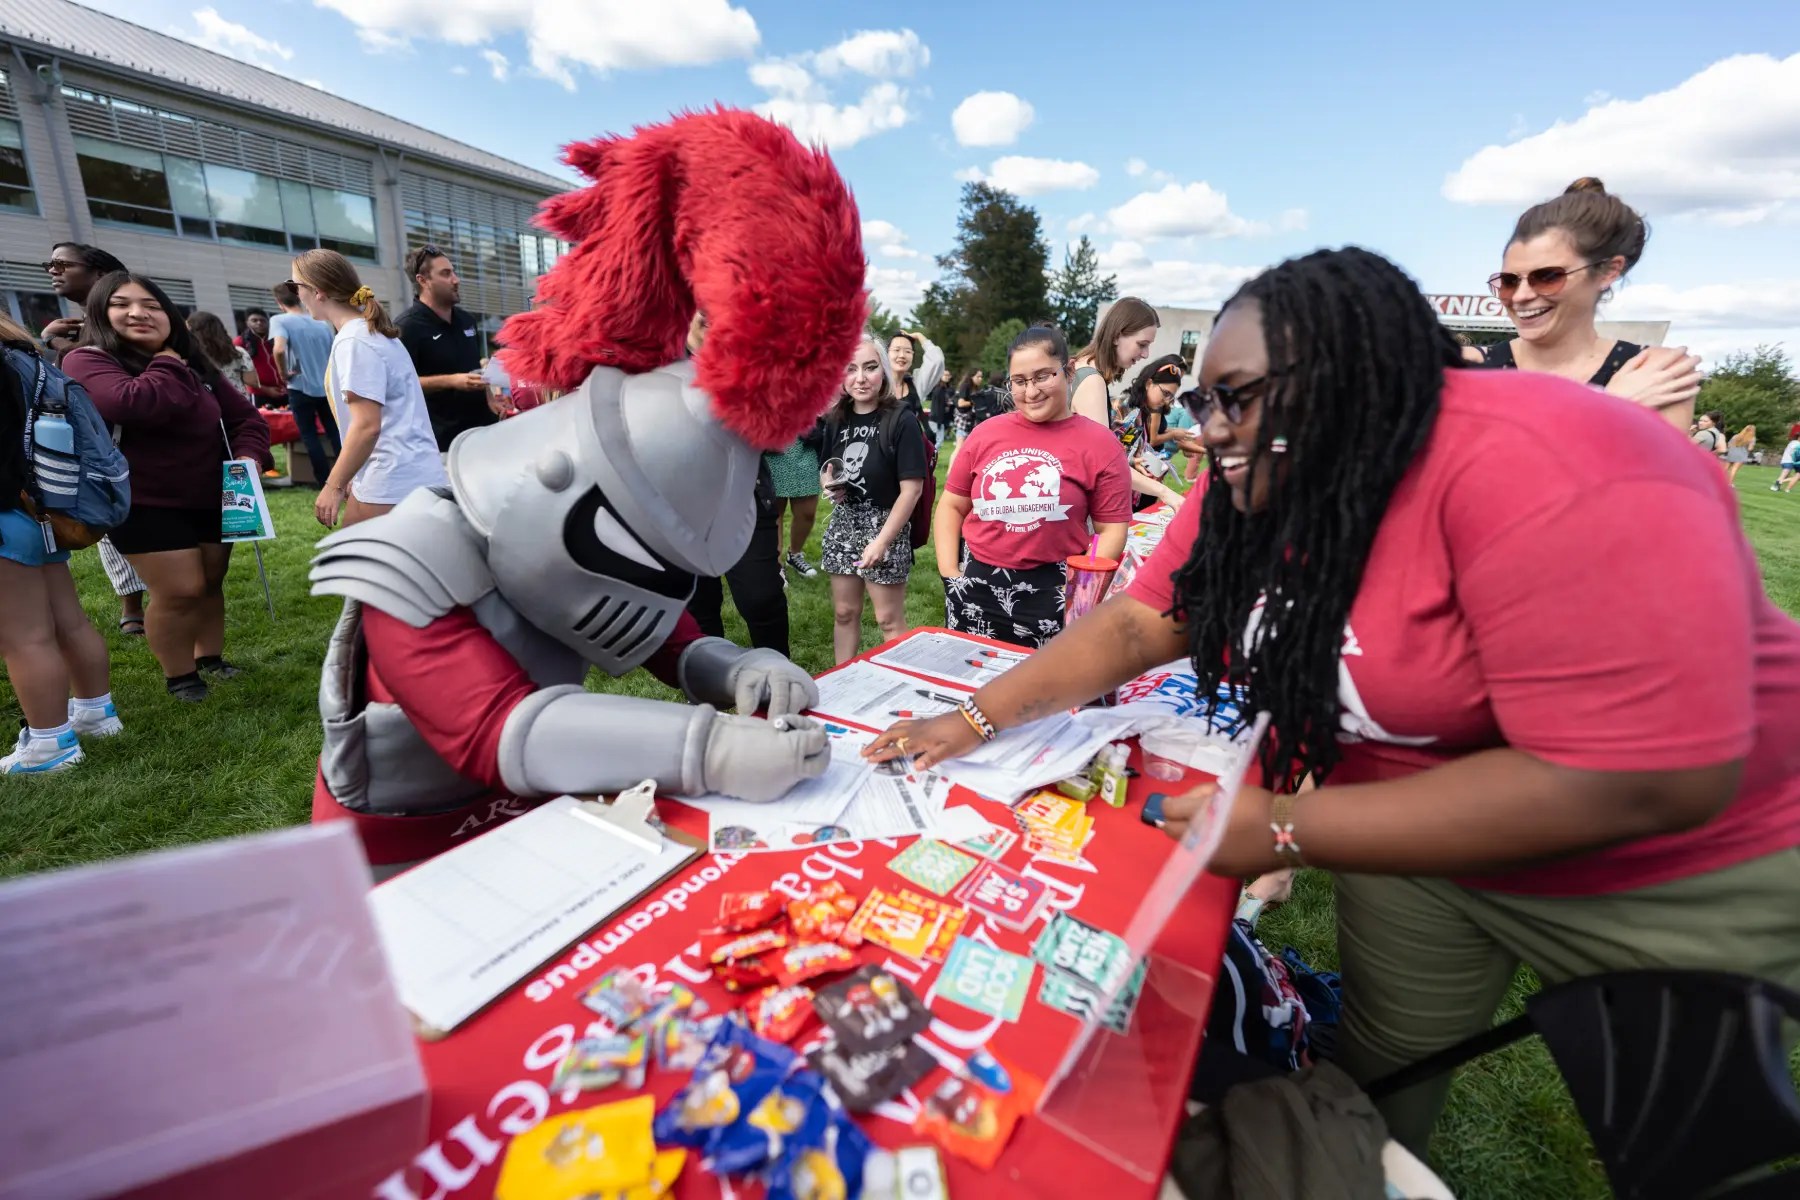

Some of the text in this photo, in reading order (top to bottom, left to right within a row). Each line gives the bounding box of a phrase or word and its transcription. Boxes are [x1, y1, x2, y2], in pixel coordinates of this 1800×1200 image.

[840, 425, 879, 442] I DON
[981, 448, 1020, 474] ARCADIA
[996, 505, 1016, 515] GLOBAL
[1017, 503, 1055, 513] ENGAGEMENT
[997, 881, 1029, 914] SP
[525, 850, 749, 1003] eyondcampus
[955, 947, 994, 997] LND
[980, 955, 1018, 1009] SCOT
